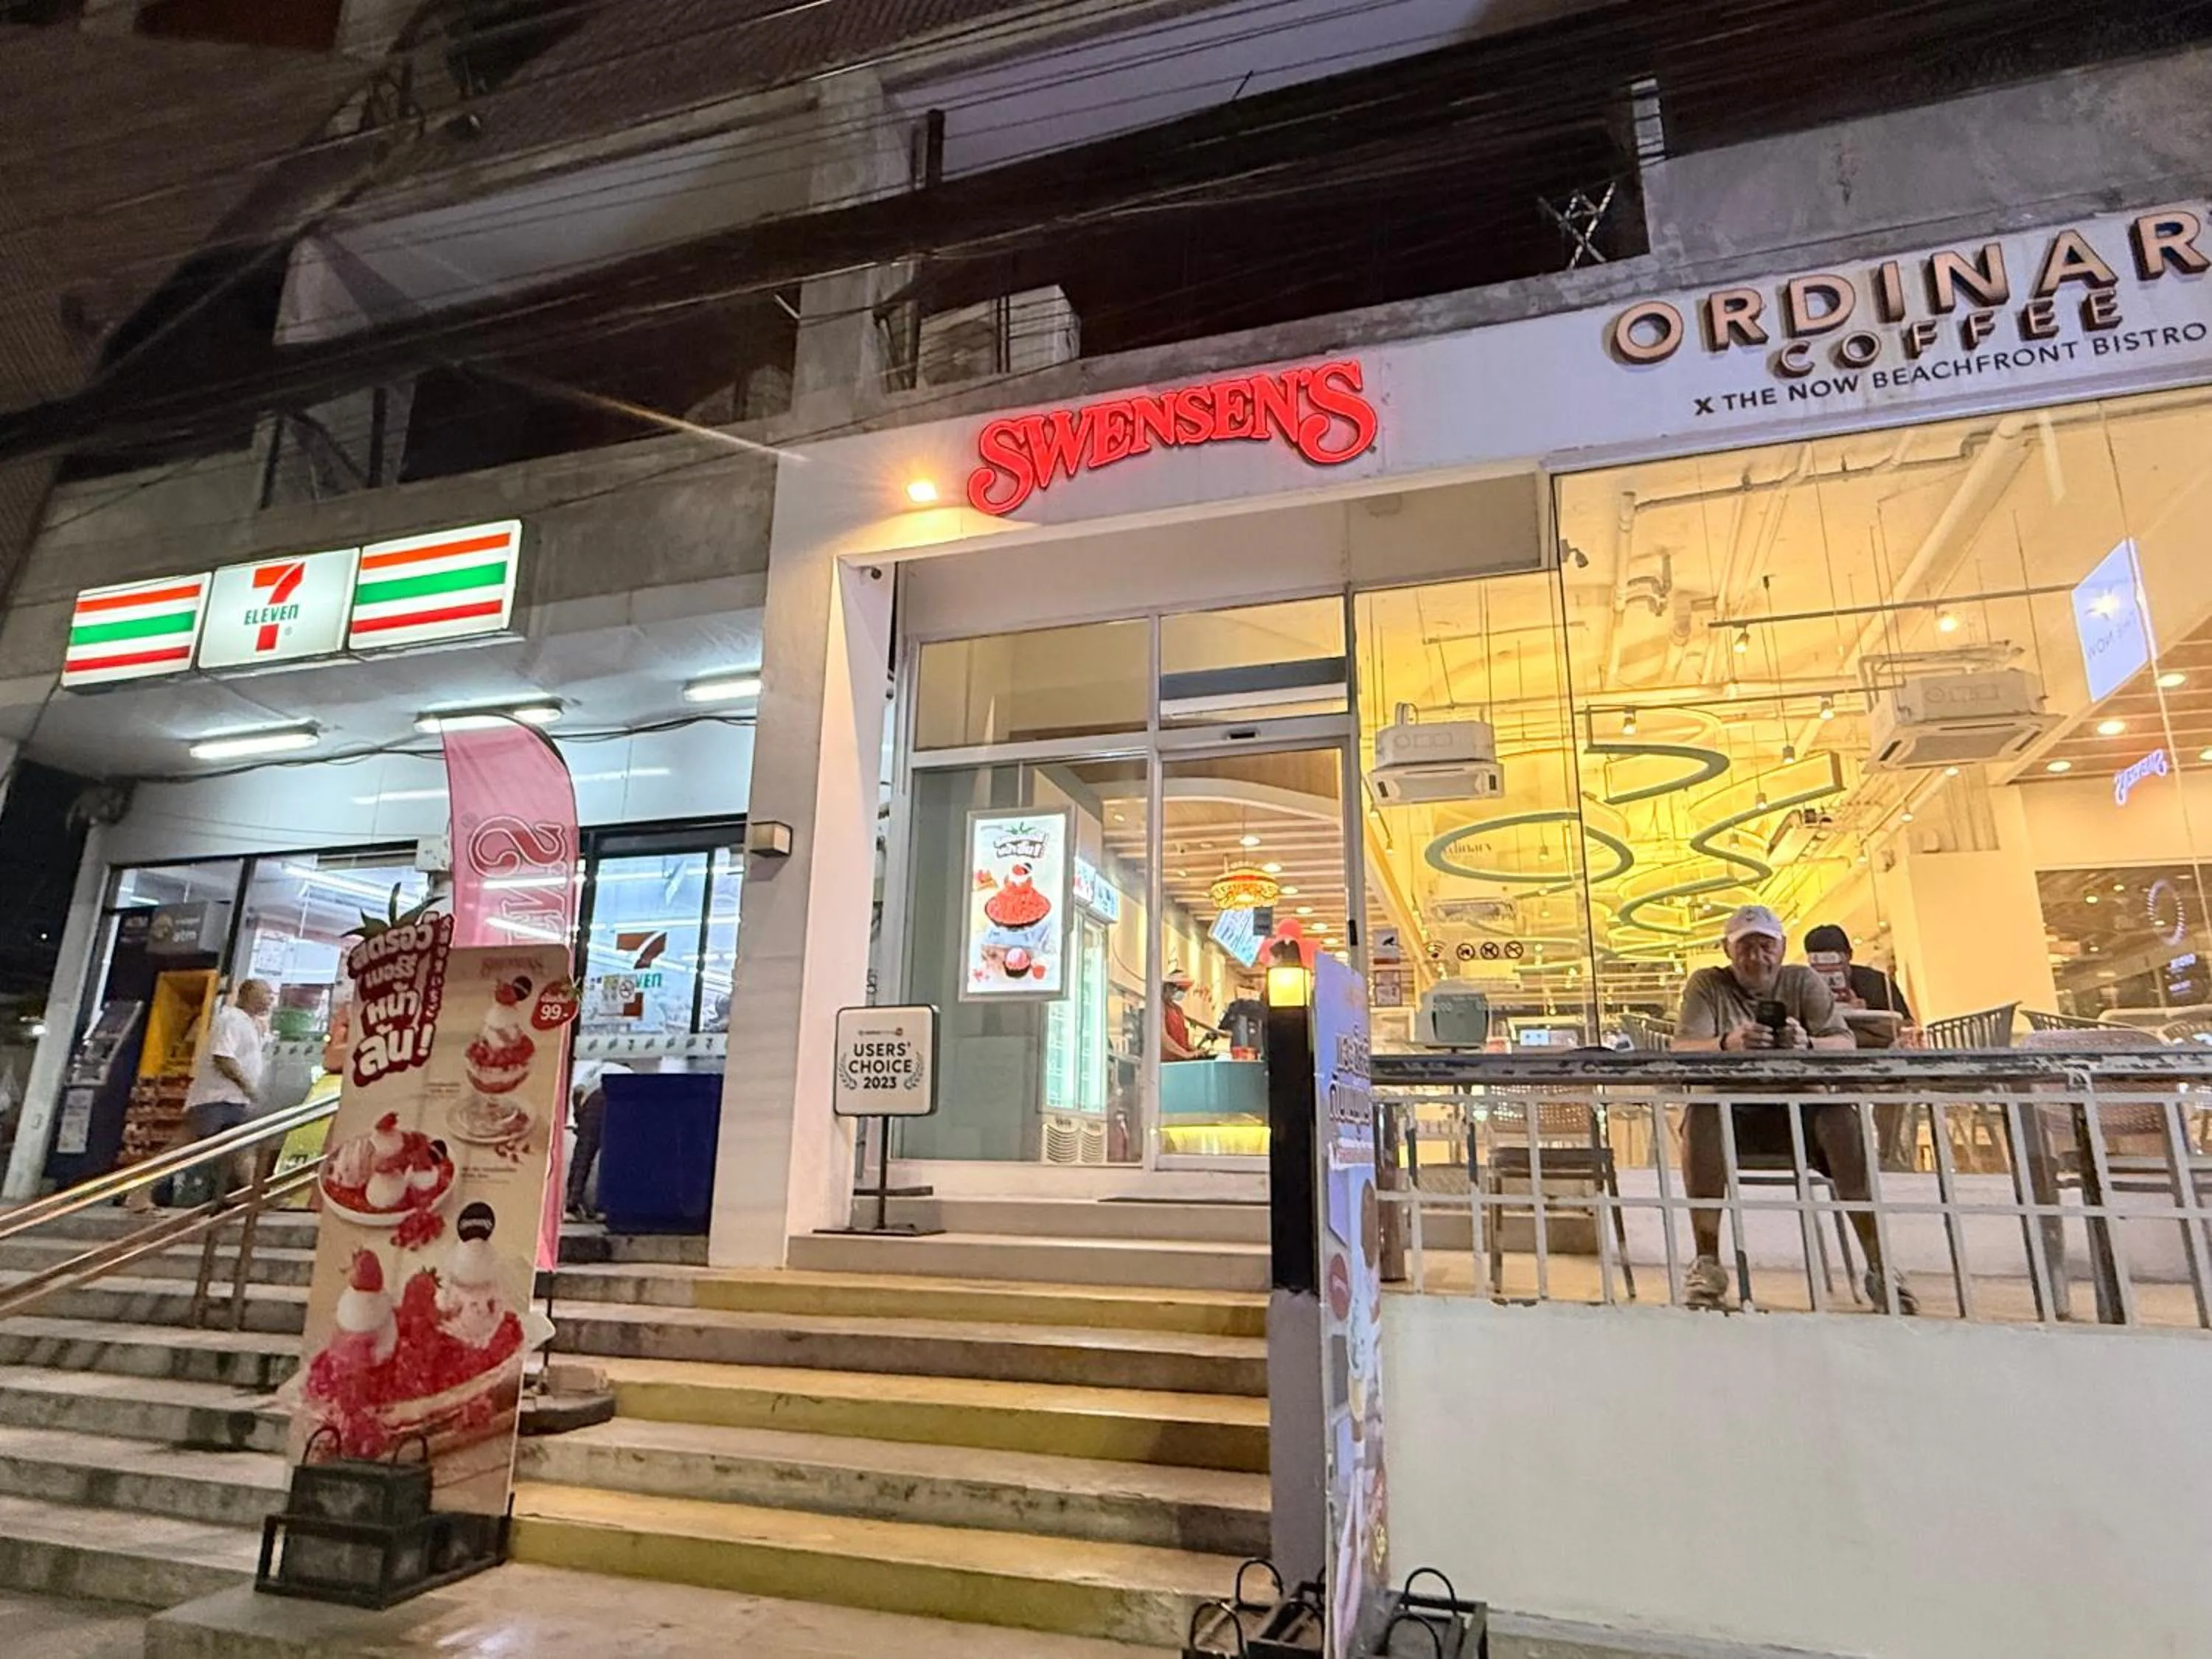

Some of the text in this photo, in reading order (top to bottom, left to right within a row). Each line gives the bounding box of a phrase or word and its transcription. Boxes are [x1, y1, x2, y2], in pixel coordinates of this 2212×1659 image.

[1614, 211, 2212, 364] ORDINAR
[1722, 388, 1777, 410] THE
[1788, 375, 1859, 401] NOW
[1873, 341, 2079, 389] BEACHFRONT
[2093, 322, 2207, 356] BISTRO
[1775, 288, 2123, 379] COFFEE
[967, 360, 1378, 516] SWENSEN'S
[252, 562, 306, 652] 7
[366, 981, 420, 1026] หน้า
[849, 1060, 912, 1074] CHOICE
[863, 1077, 897, 1089] 2023
